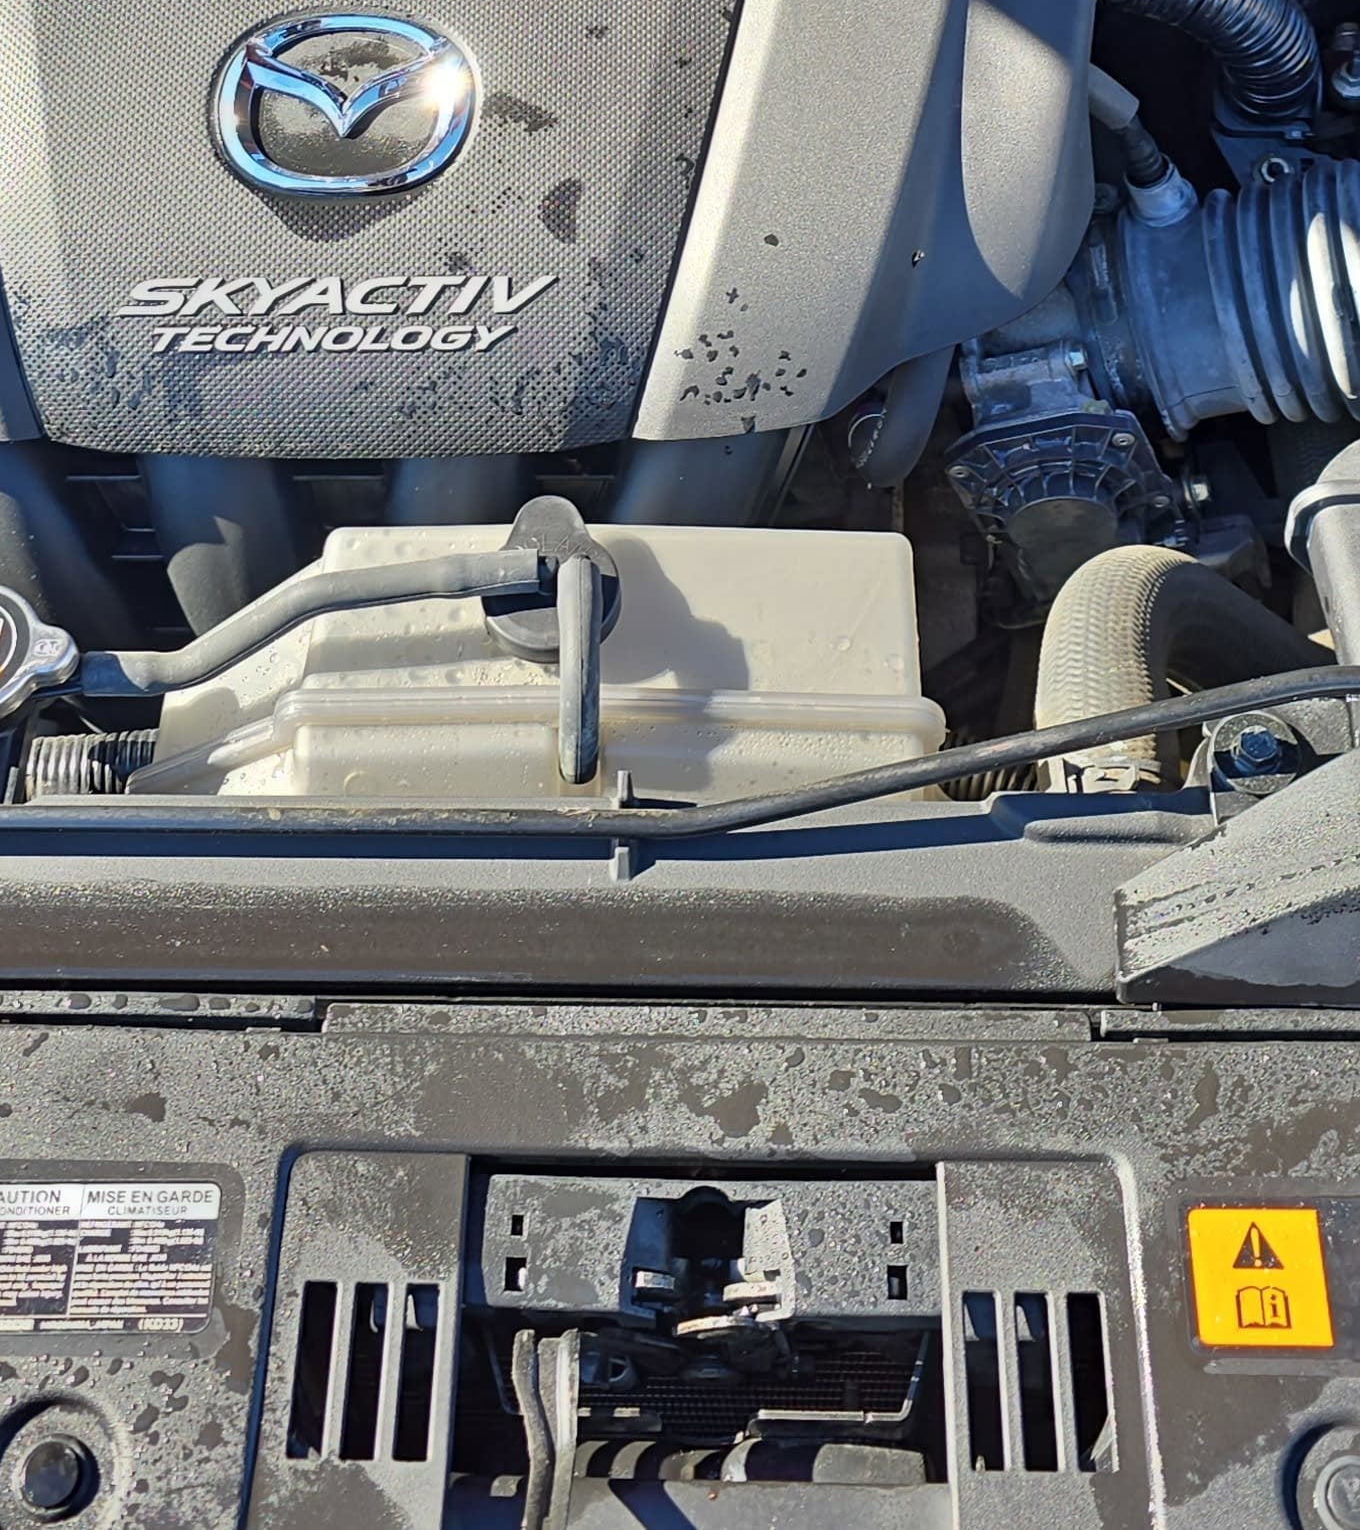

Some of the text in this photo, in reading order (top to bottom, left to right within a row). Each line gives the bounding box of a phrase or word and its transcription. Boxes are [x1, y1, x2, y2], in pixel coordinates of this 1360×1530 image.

[113, 275, 558, 317] SKYACTIV
[152, 325, 520, 353] TECHNOLOGY
[87, 1190, 213, 1203] MISE EN GARDE
[107, 1205, 188, 1216] CLIMATISEUR
